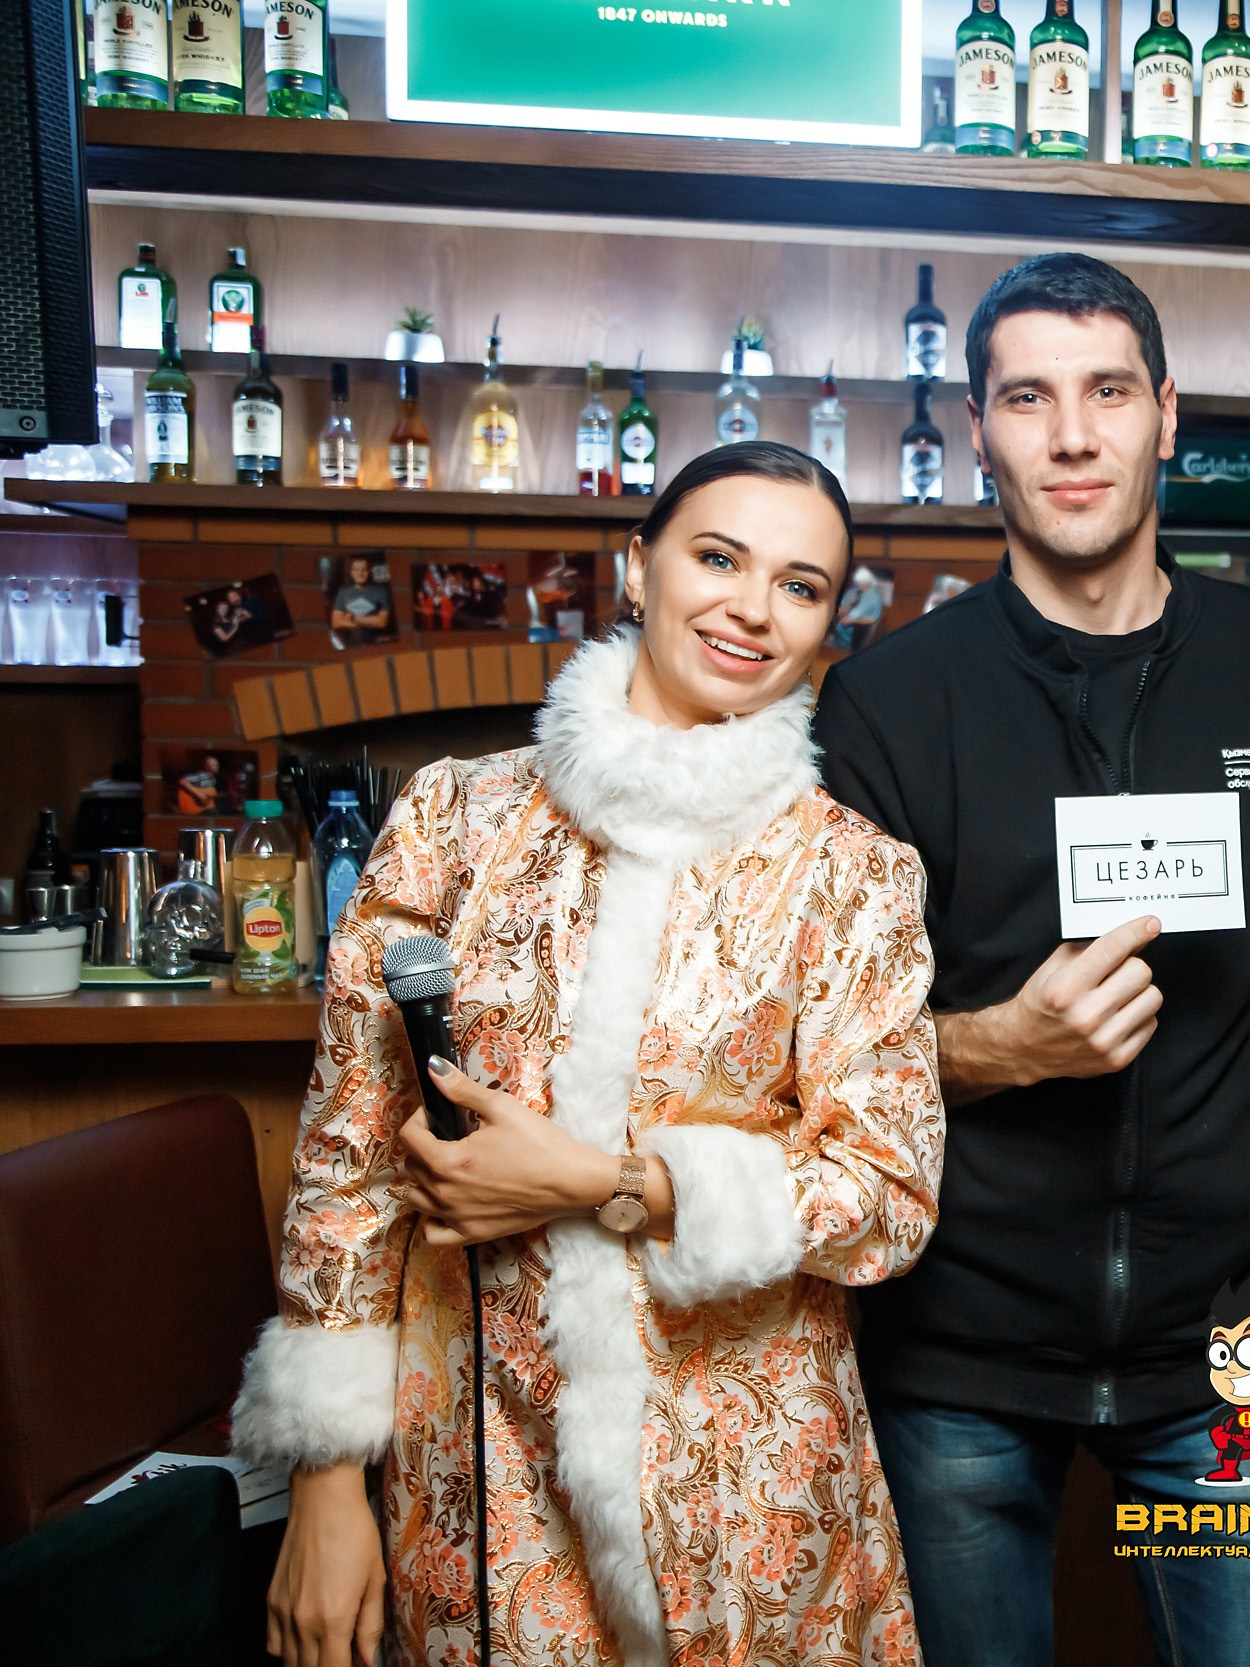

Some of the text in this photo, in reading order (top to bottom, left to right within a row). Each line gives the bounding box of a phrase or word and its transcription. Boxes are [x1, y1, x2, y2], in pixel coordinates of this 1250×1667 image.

[597, 6, 728, 28] 1847 ONWARDS
[959, 48, 1016, 70] JAMESON
[1096, 858, 1204, 884] ЦЕЗАРЬ
[1128, 893, 1175, 901] КОФЕЙНЯ
